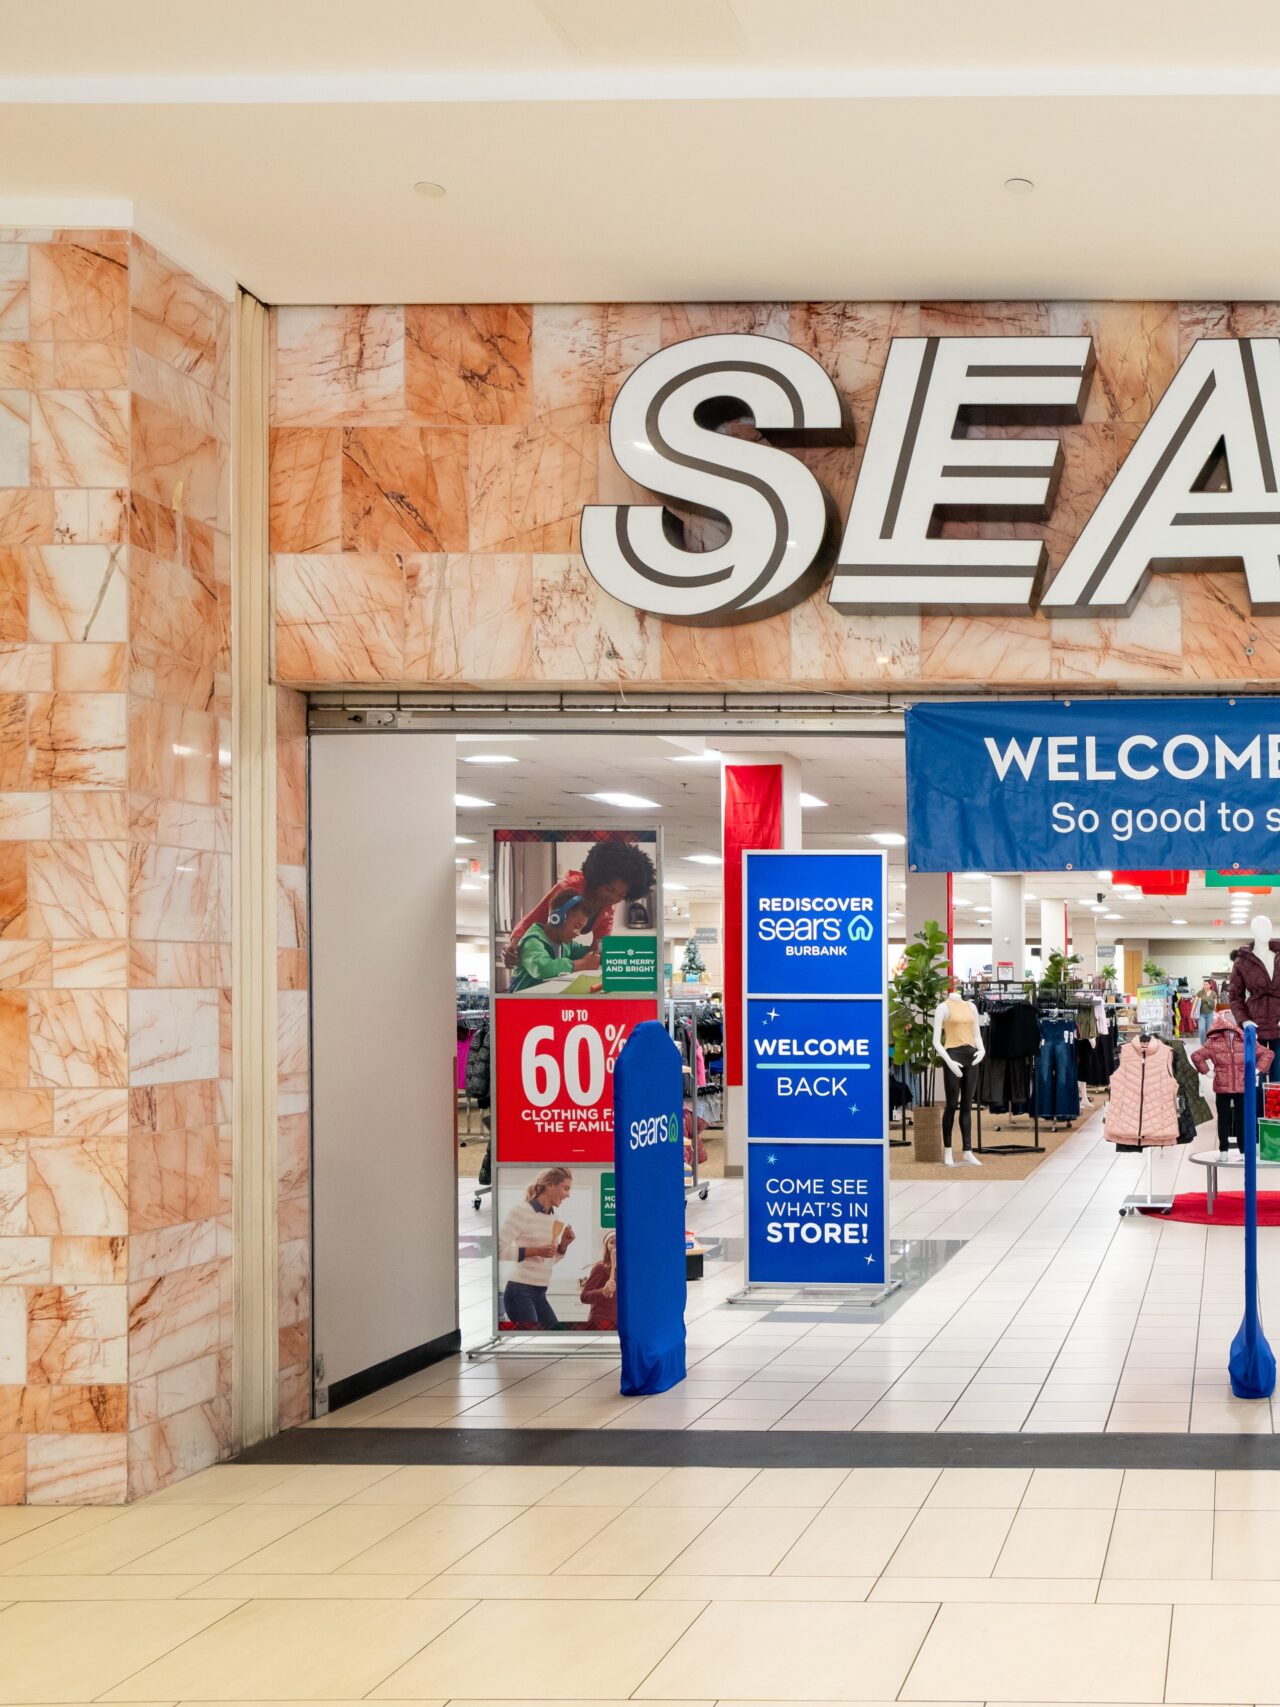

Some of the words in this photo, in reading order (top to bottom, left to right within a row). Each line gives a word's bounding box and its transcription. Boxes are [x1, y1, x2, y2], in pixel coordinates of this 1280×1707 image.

[1051, 802, 1100, 834] So
[1111, 801, 1206, 842] good
[1217, 804, 1252, 833] to
[758, 897, 873, 912] REDISCOVER
[758, 918, 842, 941] sears
[785, 946, 848, 956] BURBANK
[605, 958, 628, 966] MORE
[629, 958, 655, 966] MERRY
[561, 1009, 575, 1022] UP
[576, 1009, 588, 1022] TO
[753, 1038, 869, 1056] WELCOME
[777, 1077, 848, 1096] BACK
[521, 1108, 599, 1121] CLOTHING
[535, 1121, 565, 1132] THE
[629, 1114, 668, 1150] sears
[766, 1178, 824, 1194] COME
[831, 1179, 868, 1195] SEE
[766, 1201, 843, 1217] WHAT'S
[849, 1202, 868, 1217] IN
[766, 1221, 868, 1244] STORE!
